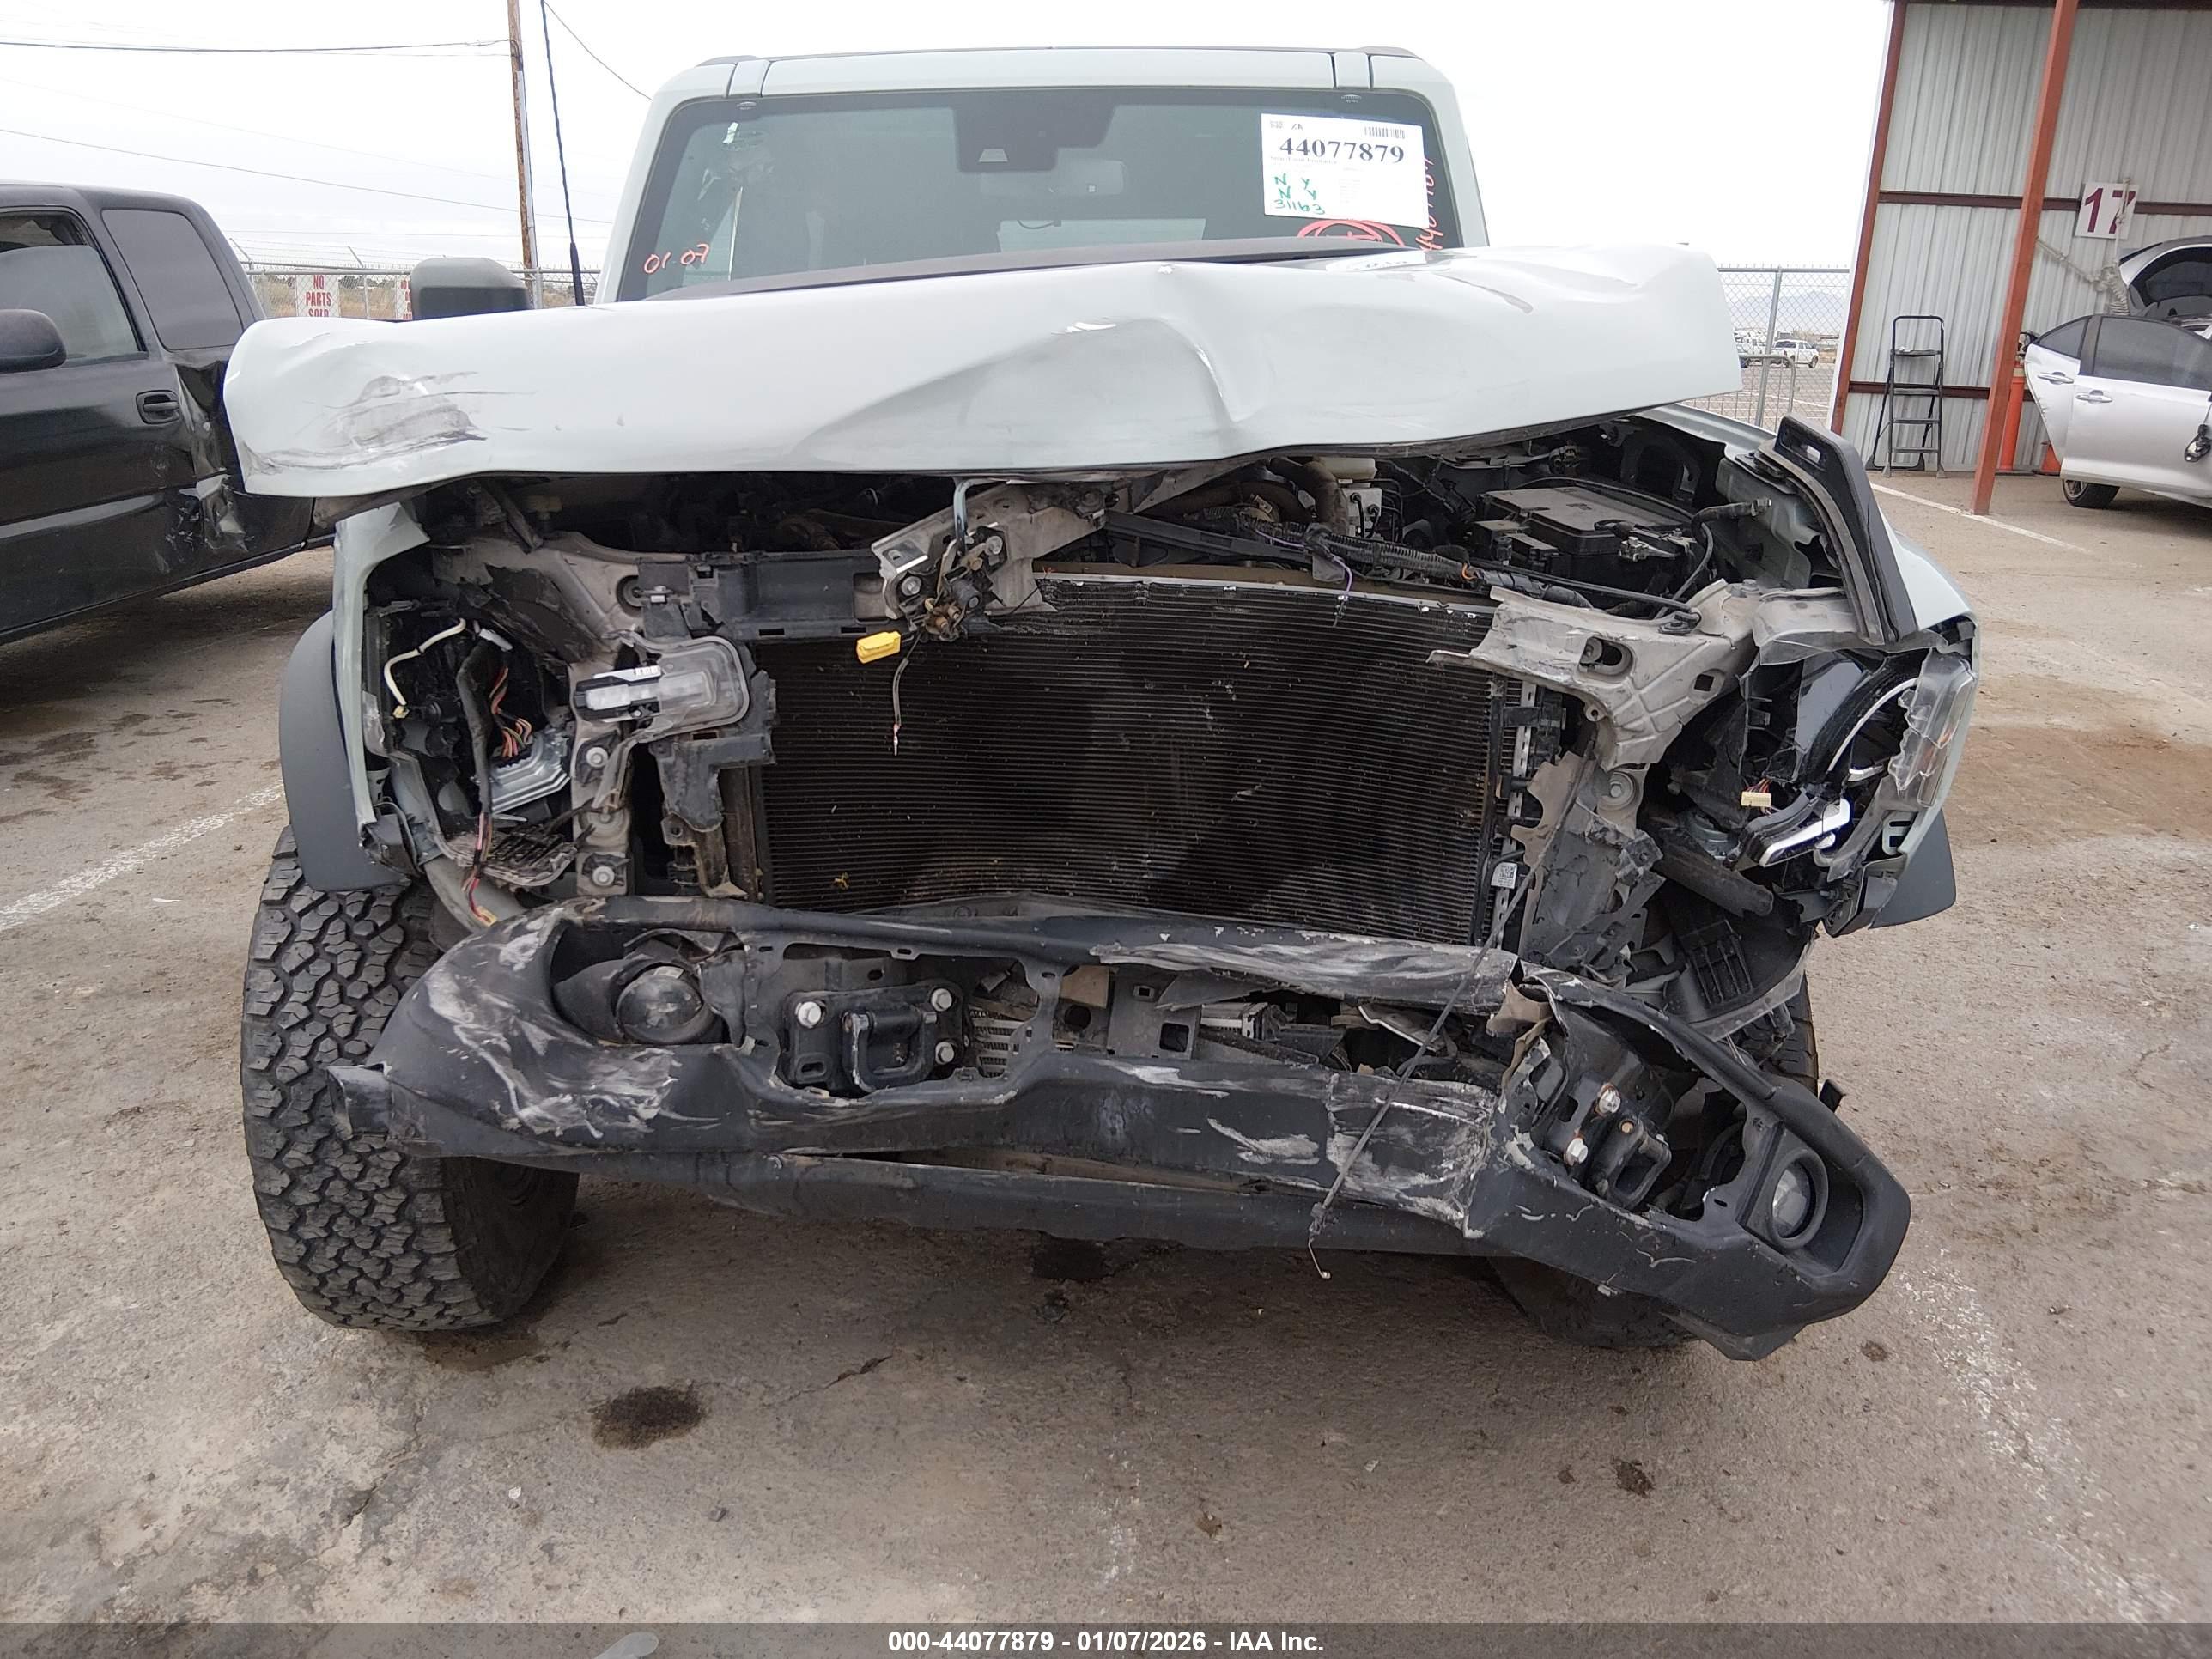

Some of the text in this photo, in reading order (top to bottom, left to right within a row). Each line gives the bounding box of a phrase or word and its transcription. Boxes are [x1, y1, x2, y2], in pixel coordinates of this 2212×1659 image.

[1279, 137, 1405, 164] 44077879
[1273, 199, 1326, 215] 31163
[2084, 187, 2136, 234] 17
[643, 243, 710, 274] 01 07
[313, 275, 325, 289] NO
[306, 292, 331, 307] PARTS
